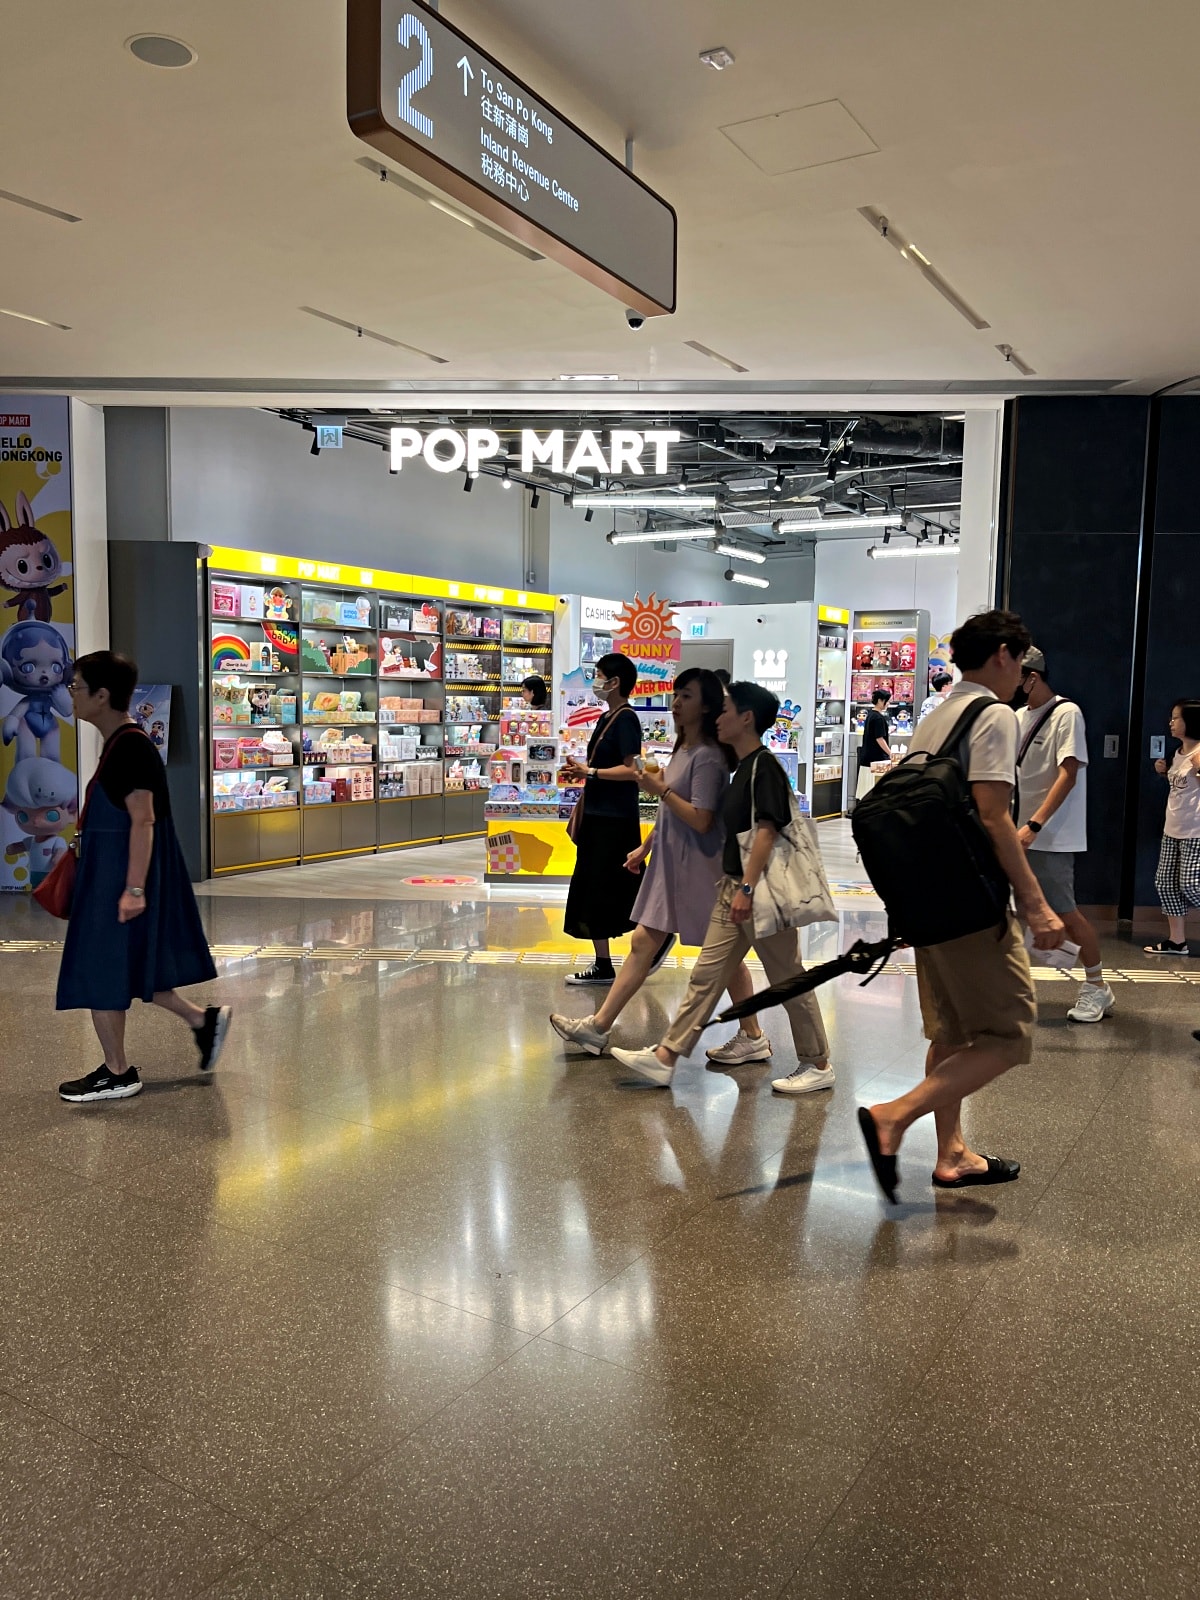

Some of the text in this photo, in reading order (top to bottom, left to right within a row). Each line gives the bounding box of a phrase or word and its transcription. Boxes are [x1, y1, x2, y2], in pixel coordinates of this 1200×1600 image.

[398, 13, 433, 139] 2
[480, 68, 553, 145] To San Po Kong
[480, 95, 529, 148] 往新蒲崗
[480, 127, 579, 212] Inland Revenue Centre
[8, 416, 29, 426] MART
[0, 437, 32, 449] ELLO
[390, 427, 681, 475] POP MART
[585, 607, 616, 621] CASHIER
[620, 643, 673, 658] SUNNY
[636, 662, 669, 679] liday
[631, 682, 656, 695] WER
